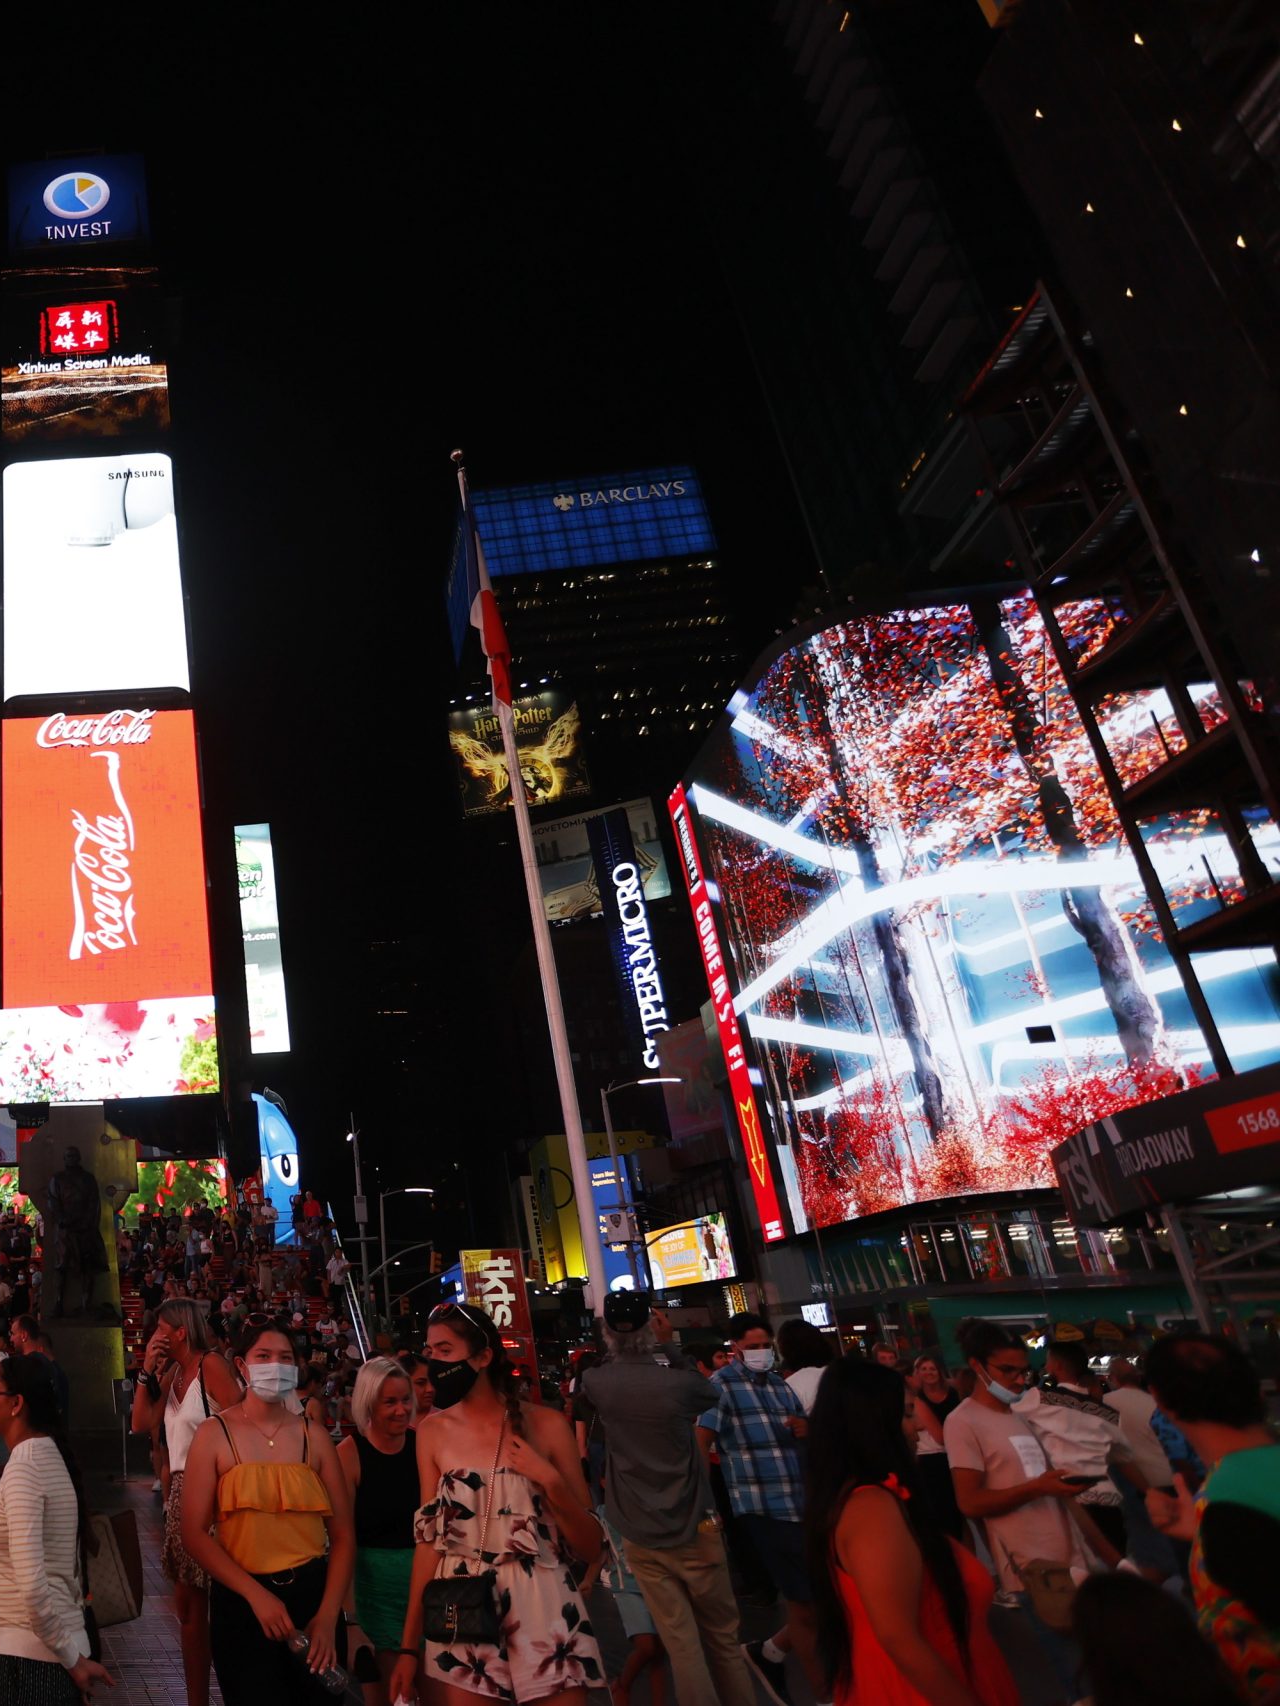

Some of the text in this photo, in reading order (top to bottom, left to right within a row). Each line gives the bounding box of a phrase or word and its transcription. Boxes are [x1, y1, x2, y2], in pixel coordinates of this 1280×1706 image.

[45, 221, 111, 240] INVEST
[18, 354, 150, 374] Xinhua Screen Media
[108, 469, 165, 480] SAMSUNG
[580, 480, 686, 507] BARCLAYS
[36, 709, 156, 749] Coca-Cola
[472, 707, 552, 740] Har Potter
[70, 808, 138, 960] Coca-Cola
[696, 901, 720, 974] COME
[1236, 1107, 1280, 1135] 1568
[1115, 1125, 1195, 1178] BROADWAY
[480, 1256, 517, 1329] tkts
